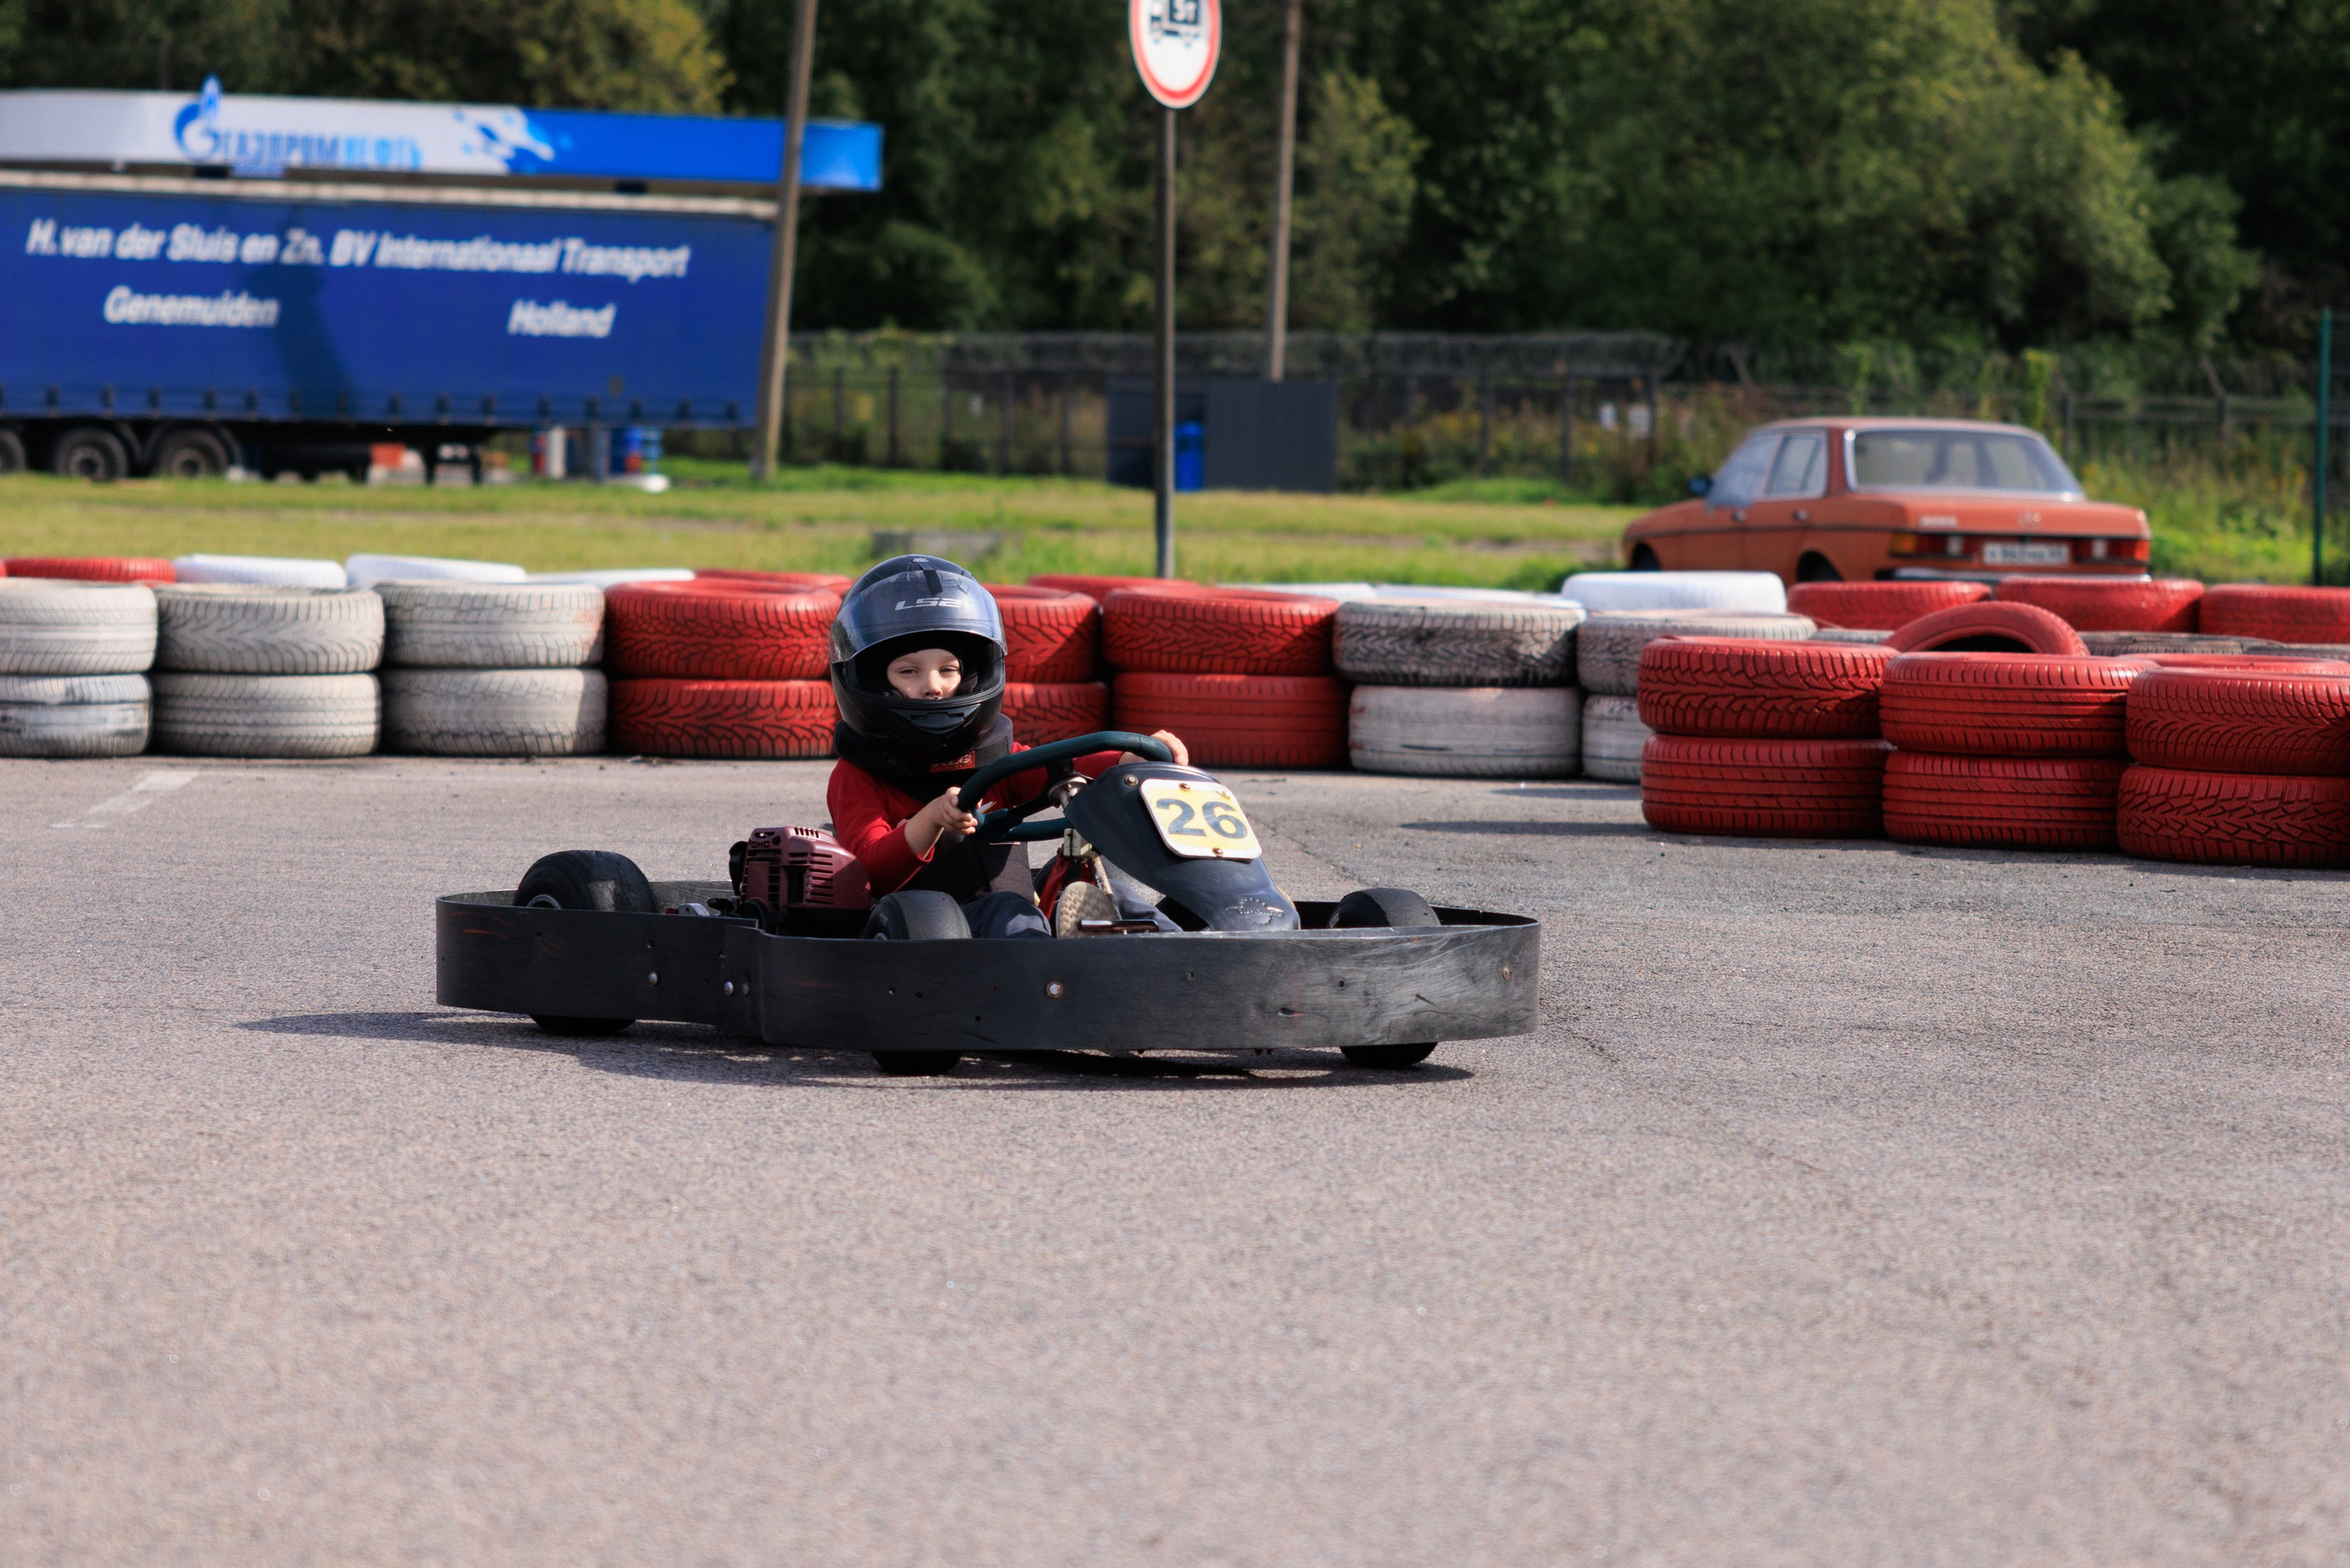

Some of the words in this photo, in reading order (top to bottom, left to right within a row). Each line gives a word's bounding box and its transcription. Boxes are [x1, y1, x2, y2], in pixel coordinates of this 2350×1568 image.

[26, 218, 59, 256] H.
[60, 226, 113, 258] van
[114, 221, 167, 261] der
[166, 222, 240, 263] Sluis
[240, 233, 279, 263] en
[328, 228, 377, 268] BV
[375, 231, 564, 273] Internationaal
[561, 236, 691, 284] Transport
[103, 285, 281, 328] Genemuiden
[507, 298, 618, 339] Holland
[894, 597, 963, 611] LS2
[1156, 798, 1248, 840] 26
